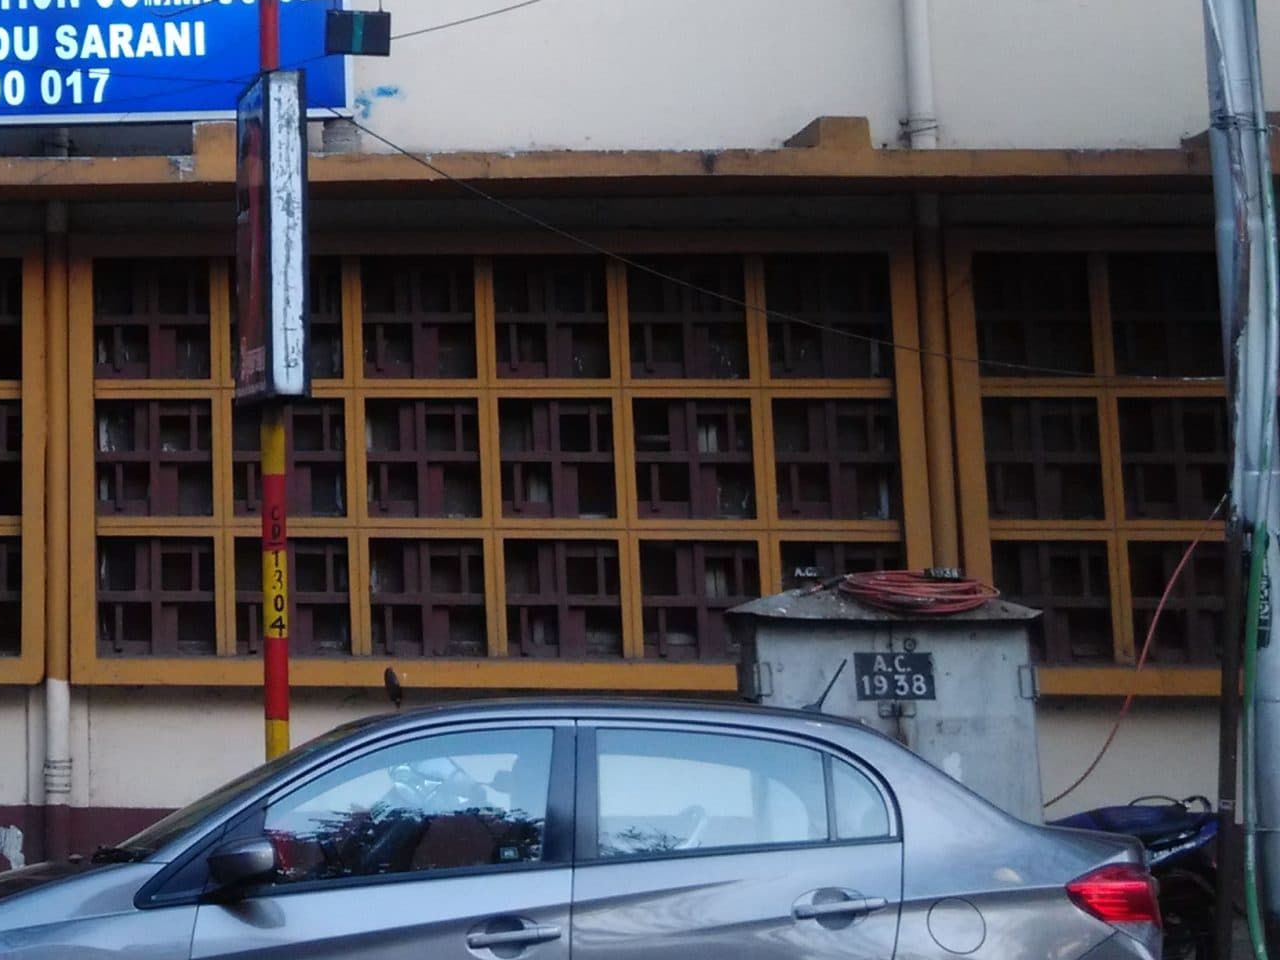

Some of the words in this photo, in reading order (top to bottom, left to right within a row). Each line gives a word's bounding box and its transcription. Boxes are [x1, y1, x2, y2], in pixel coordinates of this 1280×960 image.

[54, 20, 206, 59] SARANI
[40, 68, 111, 104] 017
[873, 655, 912, 673] A.C.
[861, 674, 927, 696] 1938
